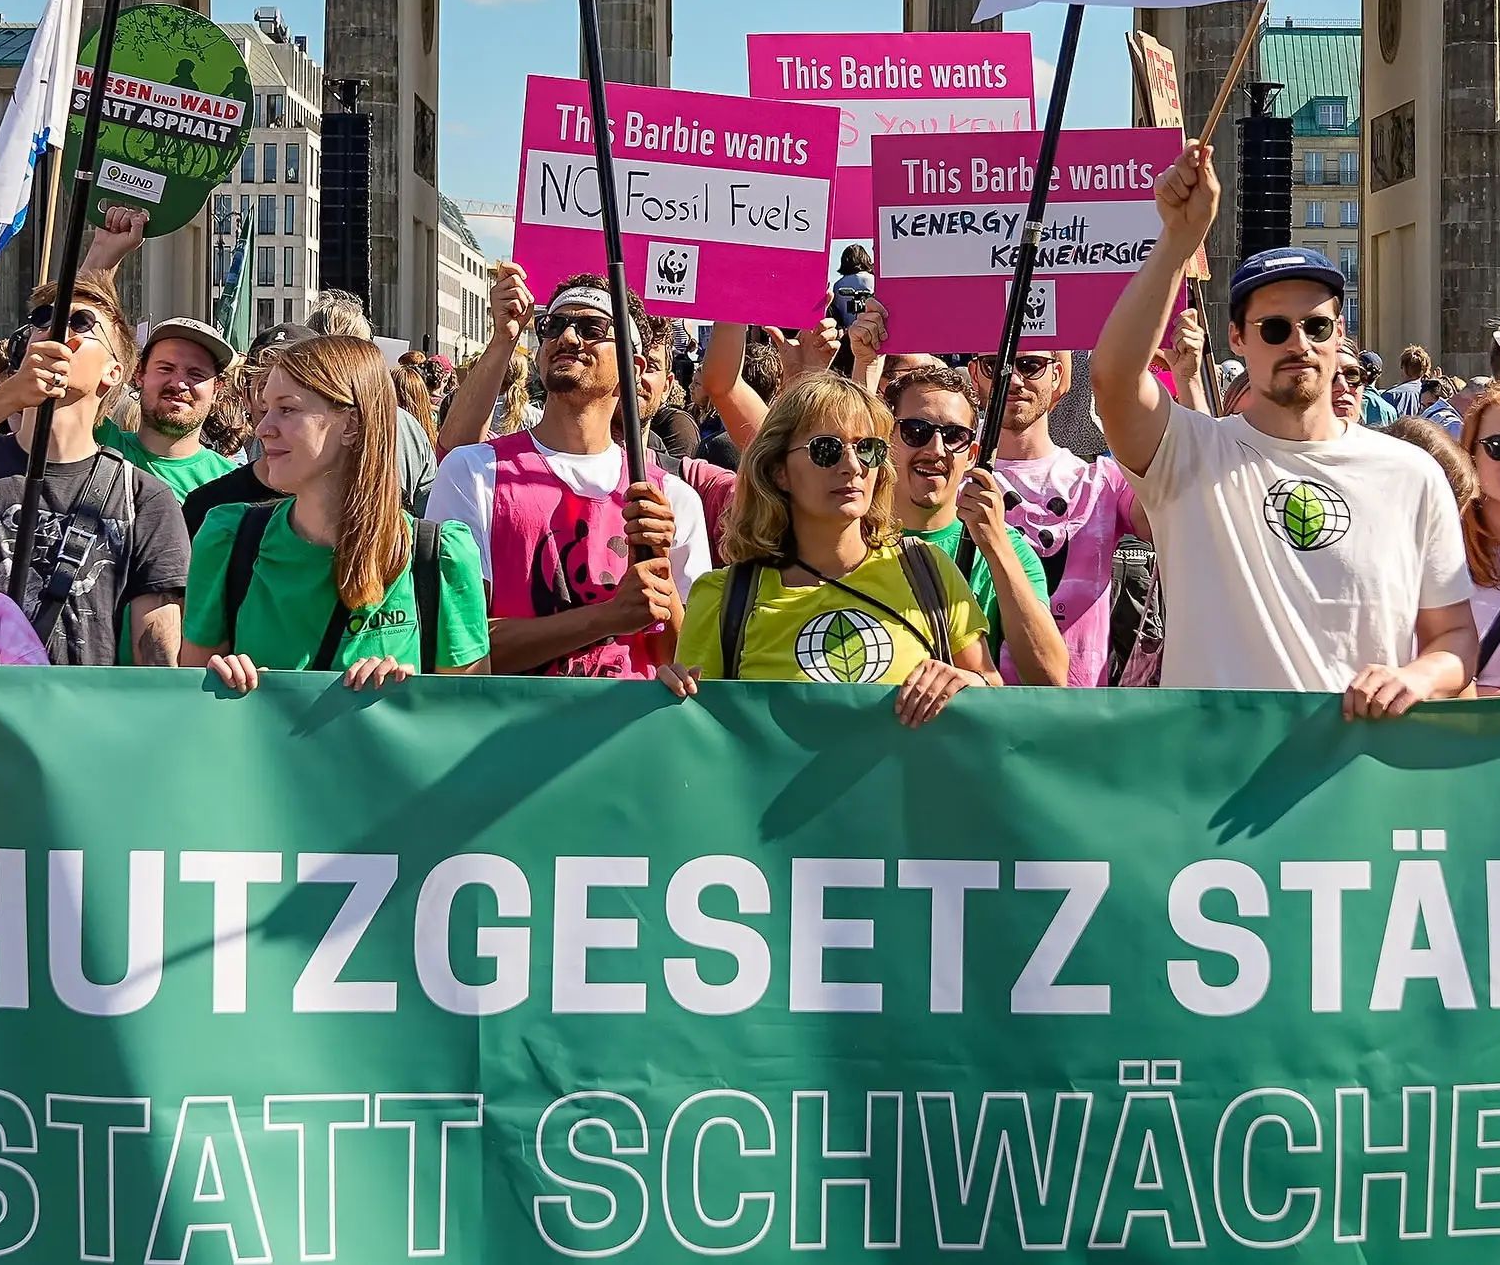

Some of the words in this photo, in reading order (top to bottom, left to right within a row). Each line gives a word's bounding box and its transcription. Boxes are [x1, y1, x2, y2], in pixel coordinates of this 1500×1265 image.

[776, 57, 833, 90] This
[840, 56, 922, 90] Barbie
[929, 59, 1008, 89] wants
[76, 69, 153, 101] WESEN
[153, 95, 177, 107] UND
[180, 93, 239, 120] WALD
[73, 93, 136, 121] SATT
[137, 108, 231, 143] ASPHALT
[556, 104, 616, 145] Ths
[624, 111, 716, 156] Barbie
[724, 131, 809, 166] wants
[120, 173, 153, 189] BUND
[901, 159, 962, 194] This
[971, 157, 1060, 193] Barbe
[1069, 159, 1154, 191] wants
[626, 171, 709, 223] Fossil
[730, 184, 811, 232] Fuels
[890, 210, 1020, 241] KENERGY
[1039, 216, 1090, 243] statt
[656, 284, 686, 296] WWF
[364, 610, 406, 629] UND
